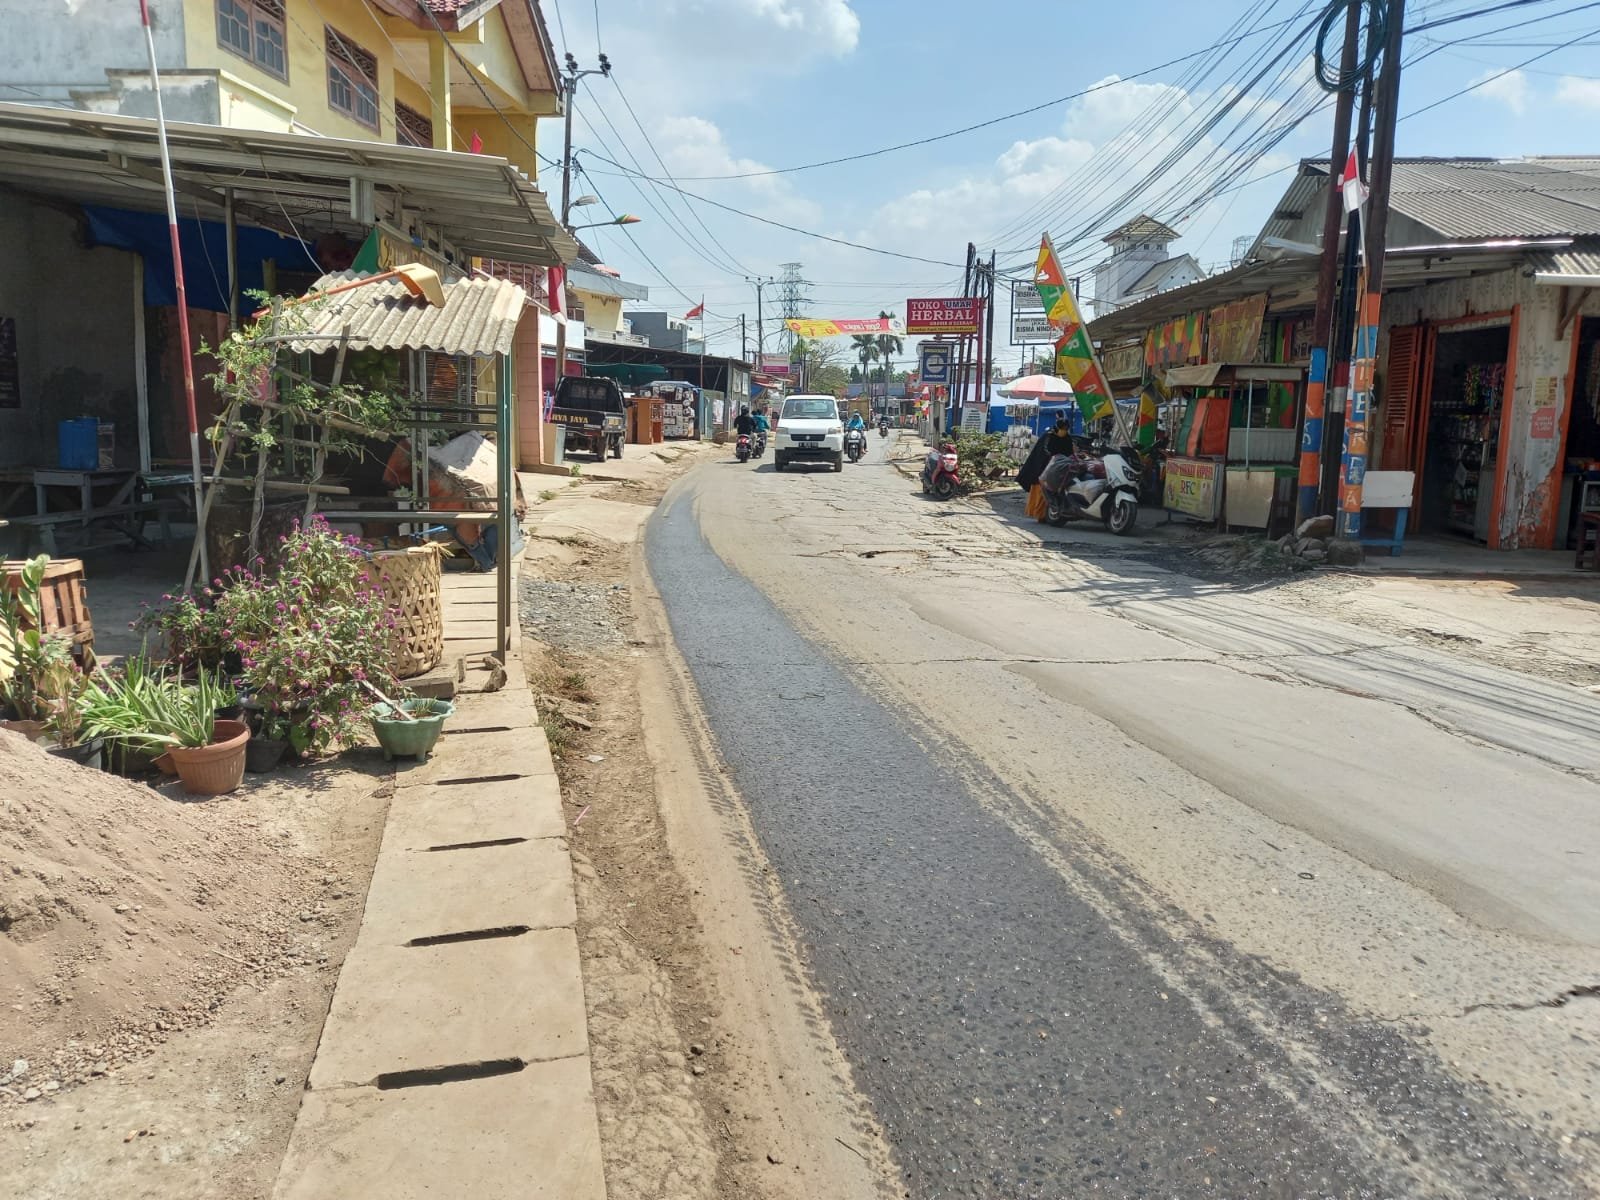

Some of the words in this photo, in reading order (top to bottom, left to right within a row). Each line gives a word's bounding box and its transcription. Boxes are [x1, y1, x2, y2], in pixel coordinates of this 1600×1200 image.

[911, 301, 941, 310] TOKO
[944, 300, 972, 309] UMAR
[911, 310, 974, 321] HERBAL
[570, 415, 589, 424] JAYA
